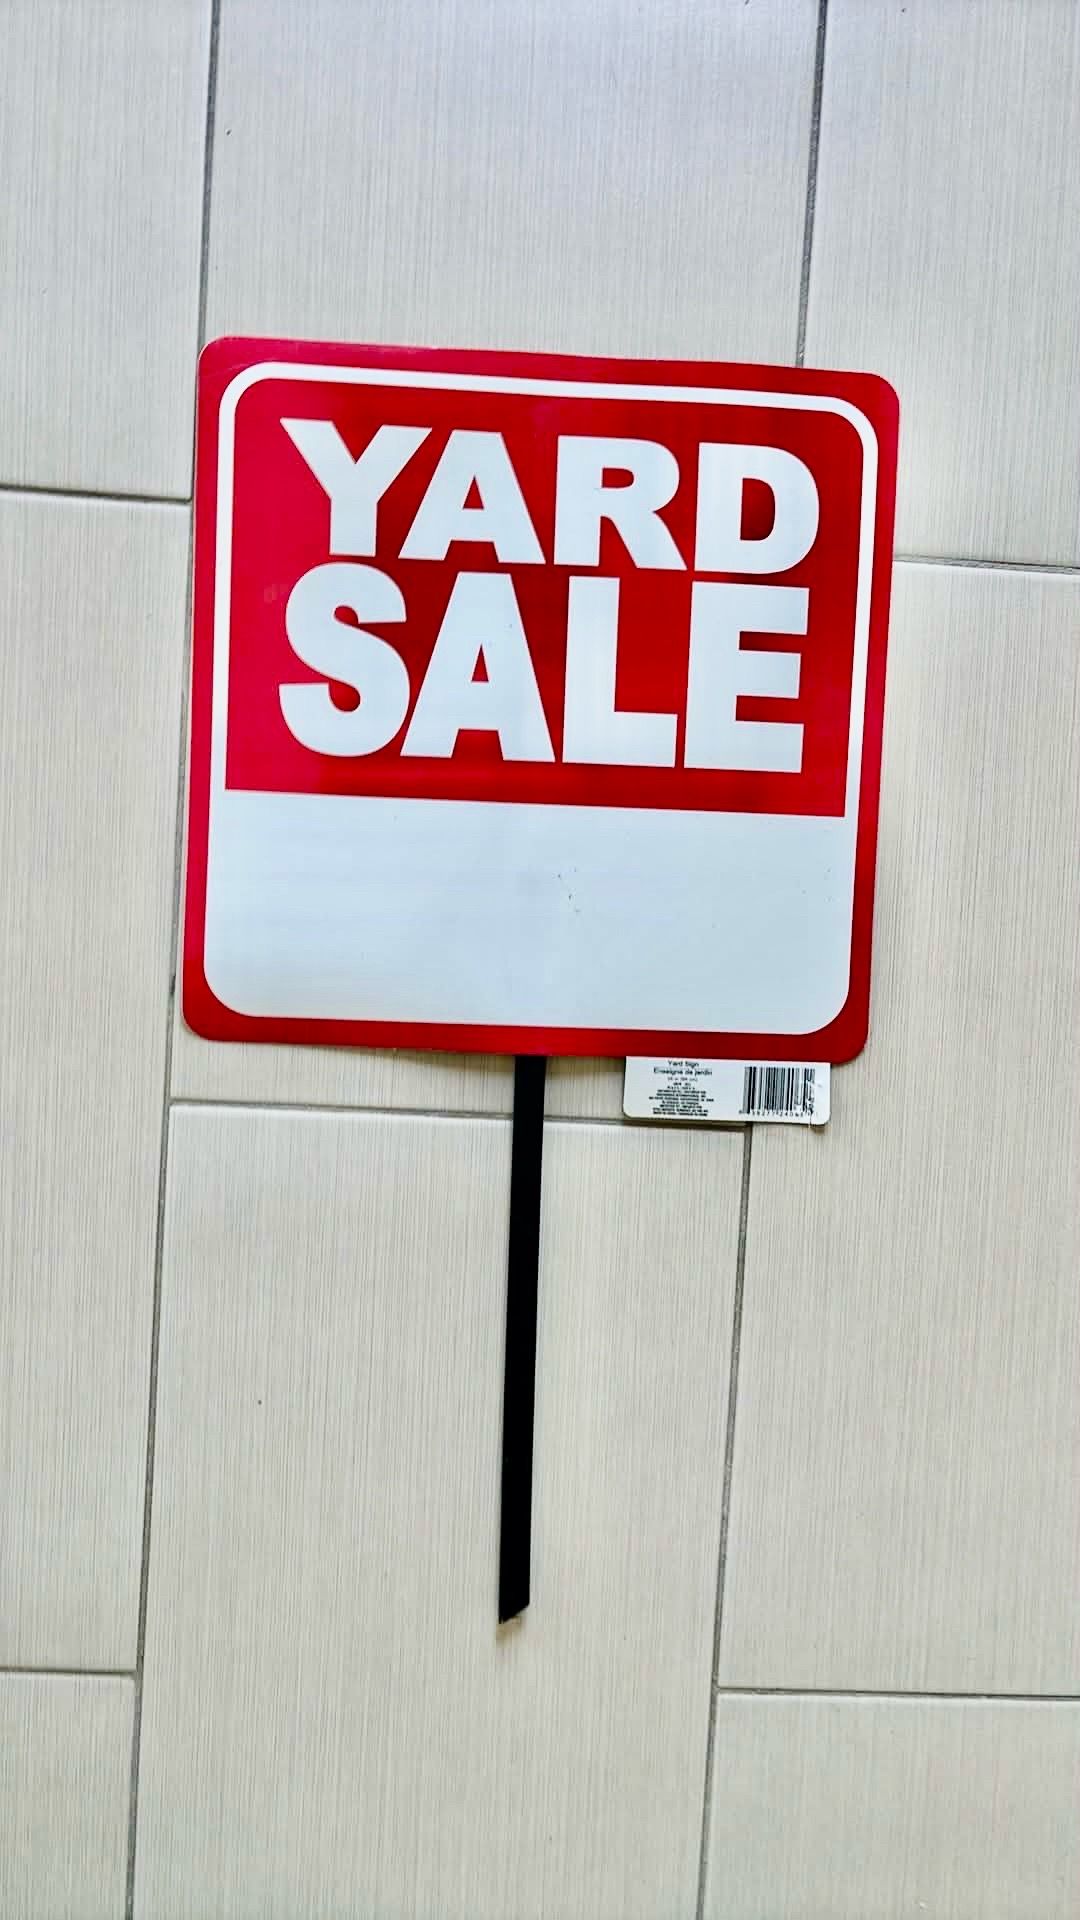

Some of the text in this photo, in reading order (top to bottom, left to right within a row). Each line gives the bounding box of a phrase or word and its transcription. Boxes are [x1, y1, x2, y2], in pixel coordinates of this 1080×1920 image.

[280, 418, 819, 574] YARD
[279, 563, 809, 773] SALE
[685, 1061, 699, 1069] Sign
